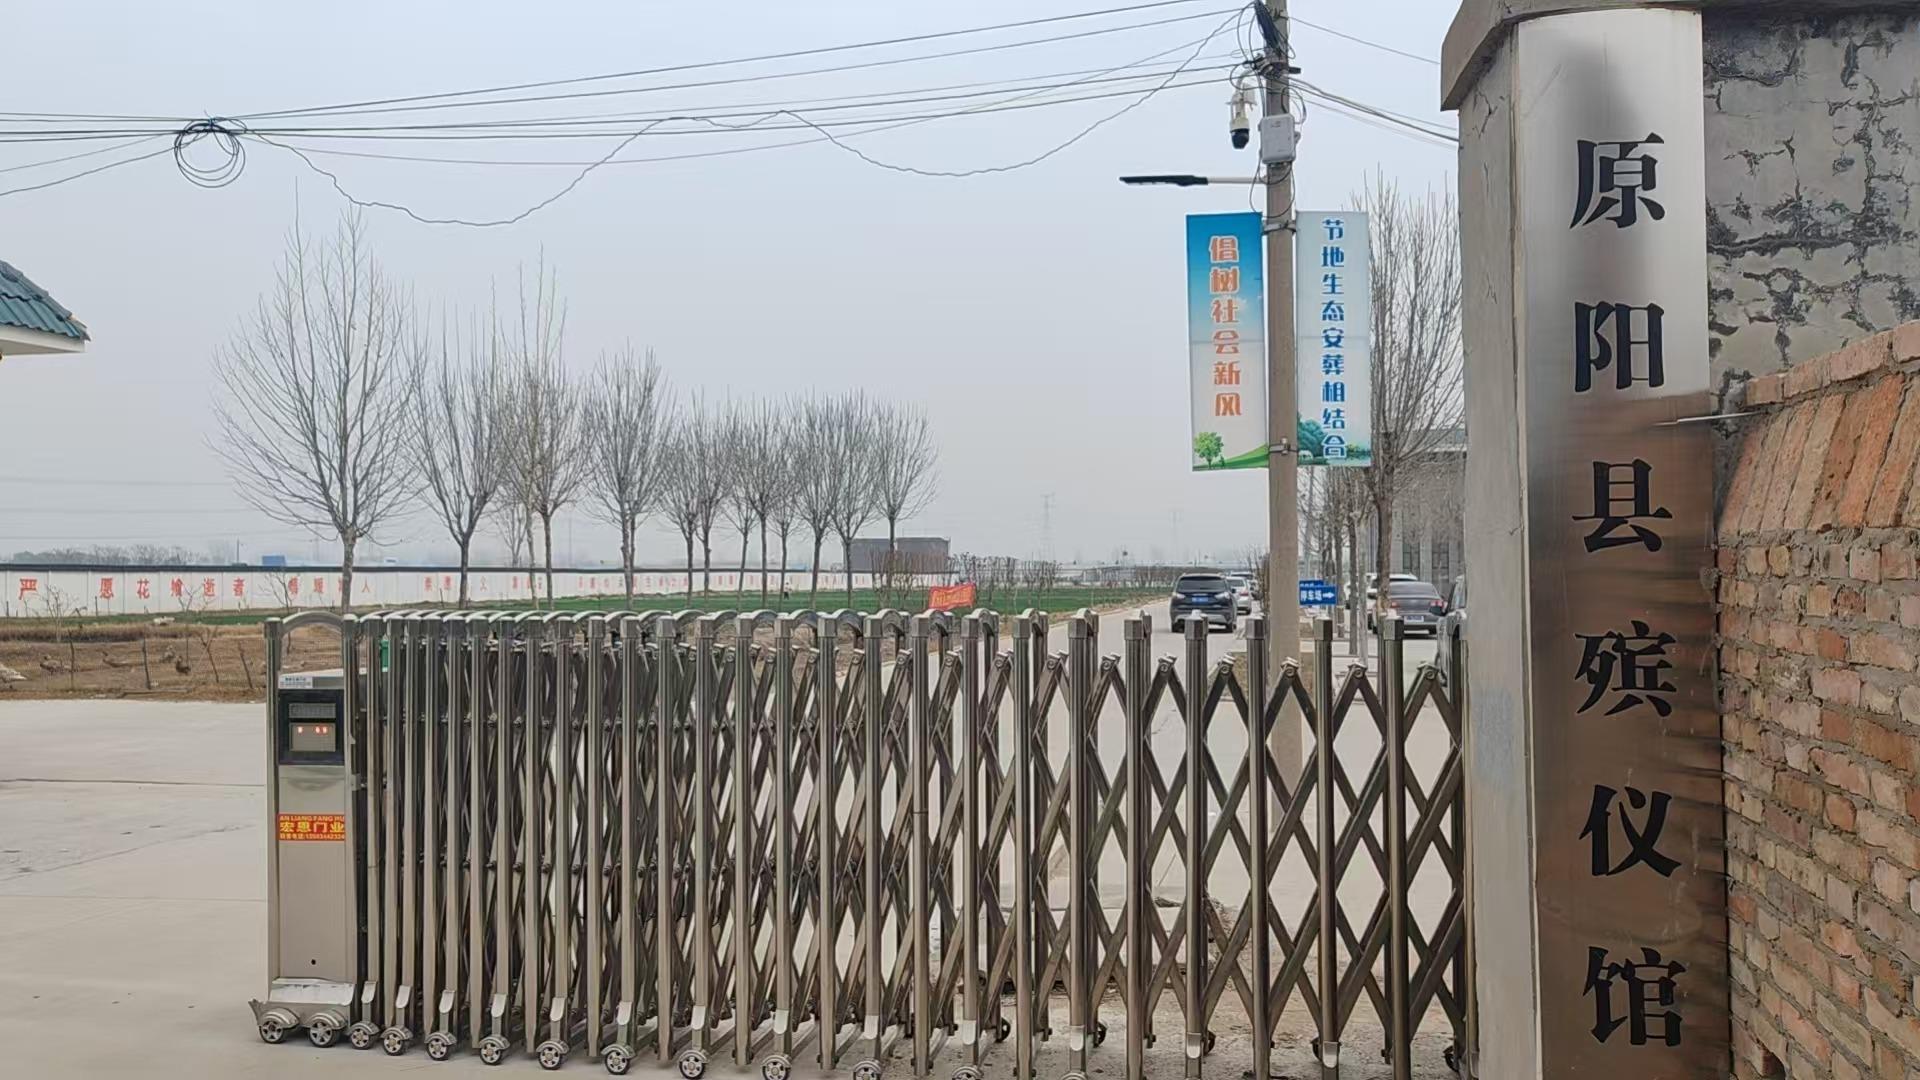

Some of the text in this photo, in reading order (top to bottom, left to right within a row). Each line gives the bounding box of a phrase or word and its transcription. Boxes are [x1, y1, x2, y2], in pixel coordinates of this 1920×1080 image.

[1209, 236, 1242, 416] 倡树社会新风
[1321, 218, 1347, 459] 节地生态安葬相结合
[1570, 132, 1687, 1047] 原阳县殡仪馆
